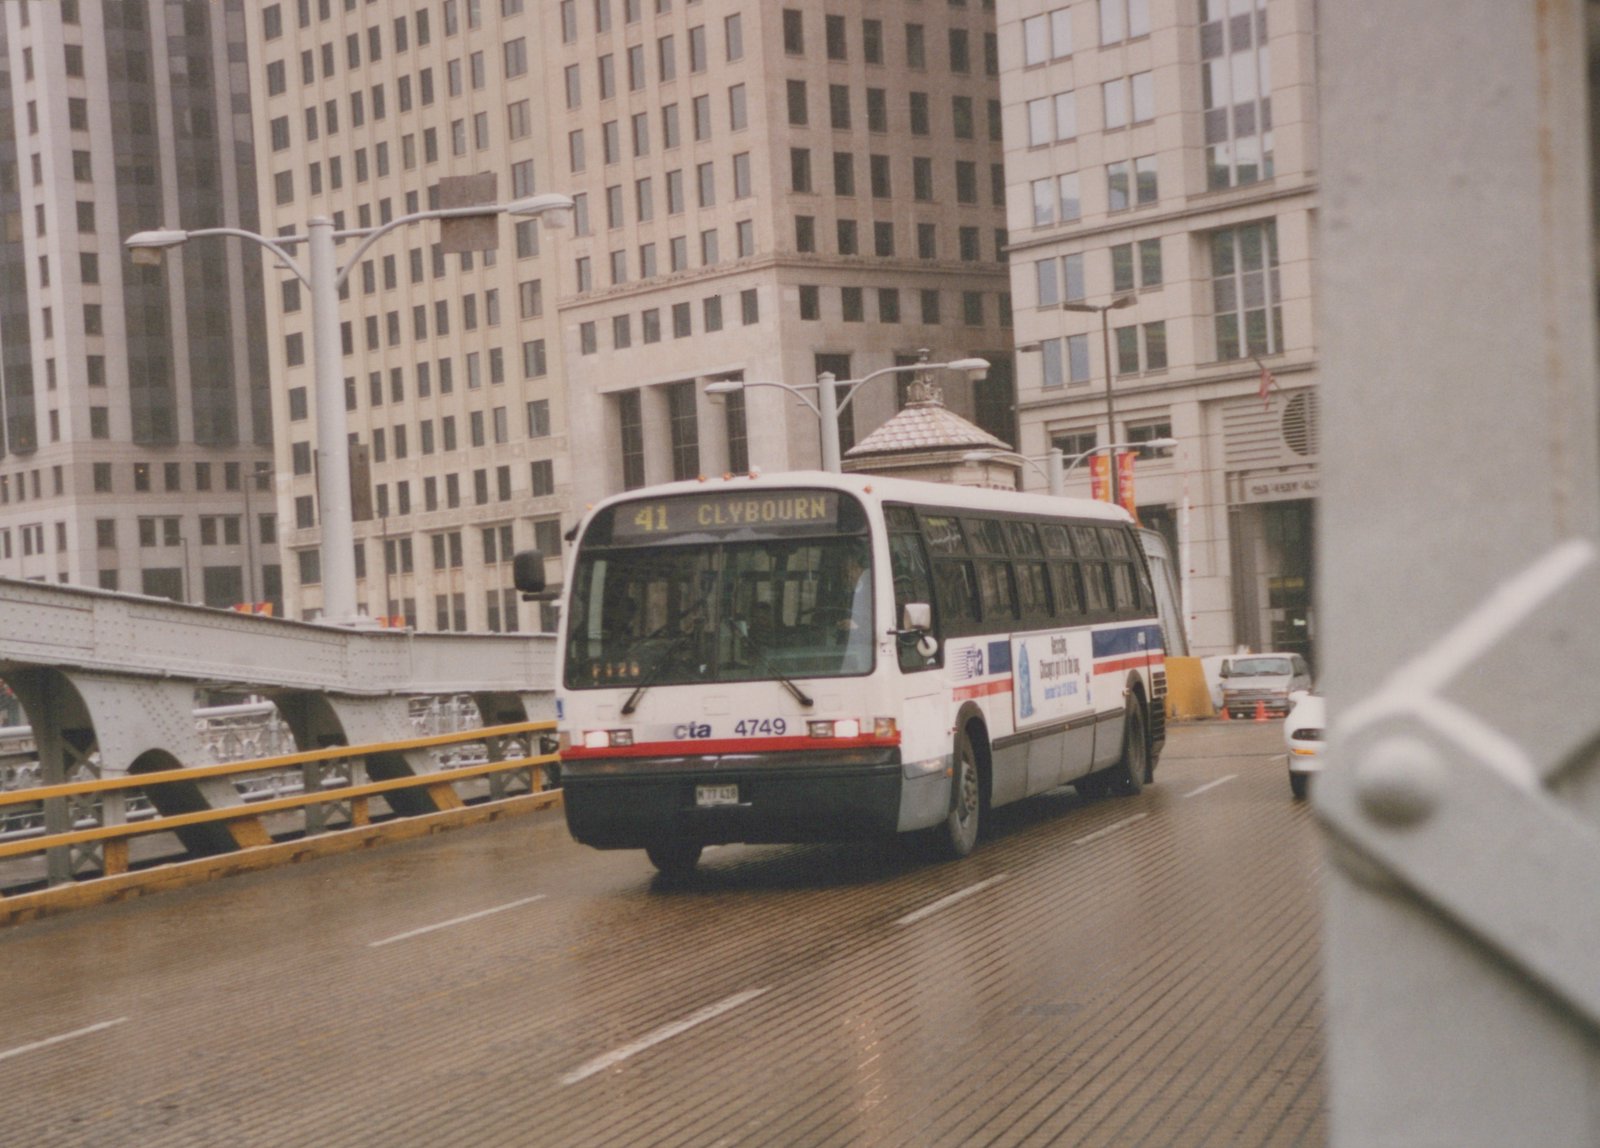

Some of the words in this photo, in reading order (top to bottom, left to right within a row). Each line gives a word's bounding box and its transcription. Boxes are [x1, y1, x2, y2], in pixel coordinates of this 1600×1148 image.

[634, 504, 669, 531] 41
[698, 497, 827, 525] CLYBOURN
[673, 721, 712, 739] cta
[734, 717, 787, 736] 4749
